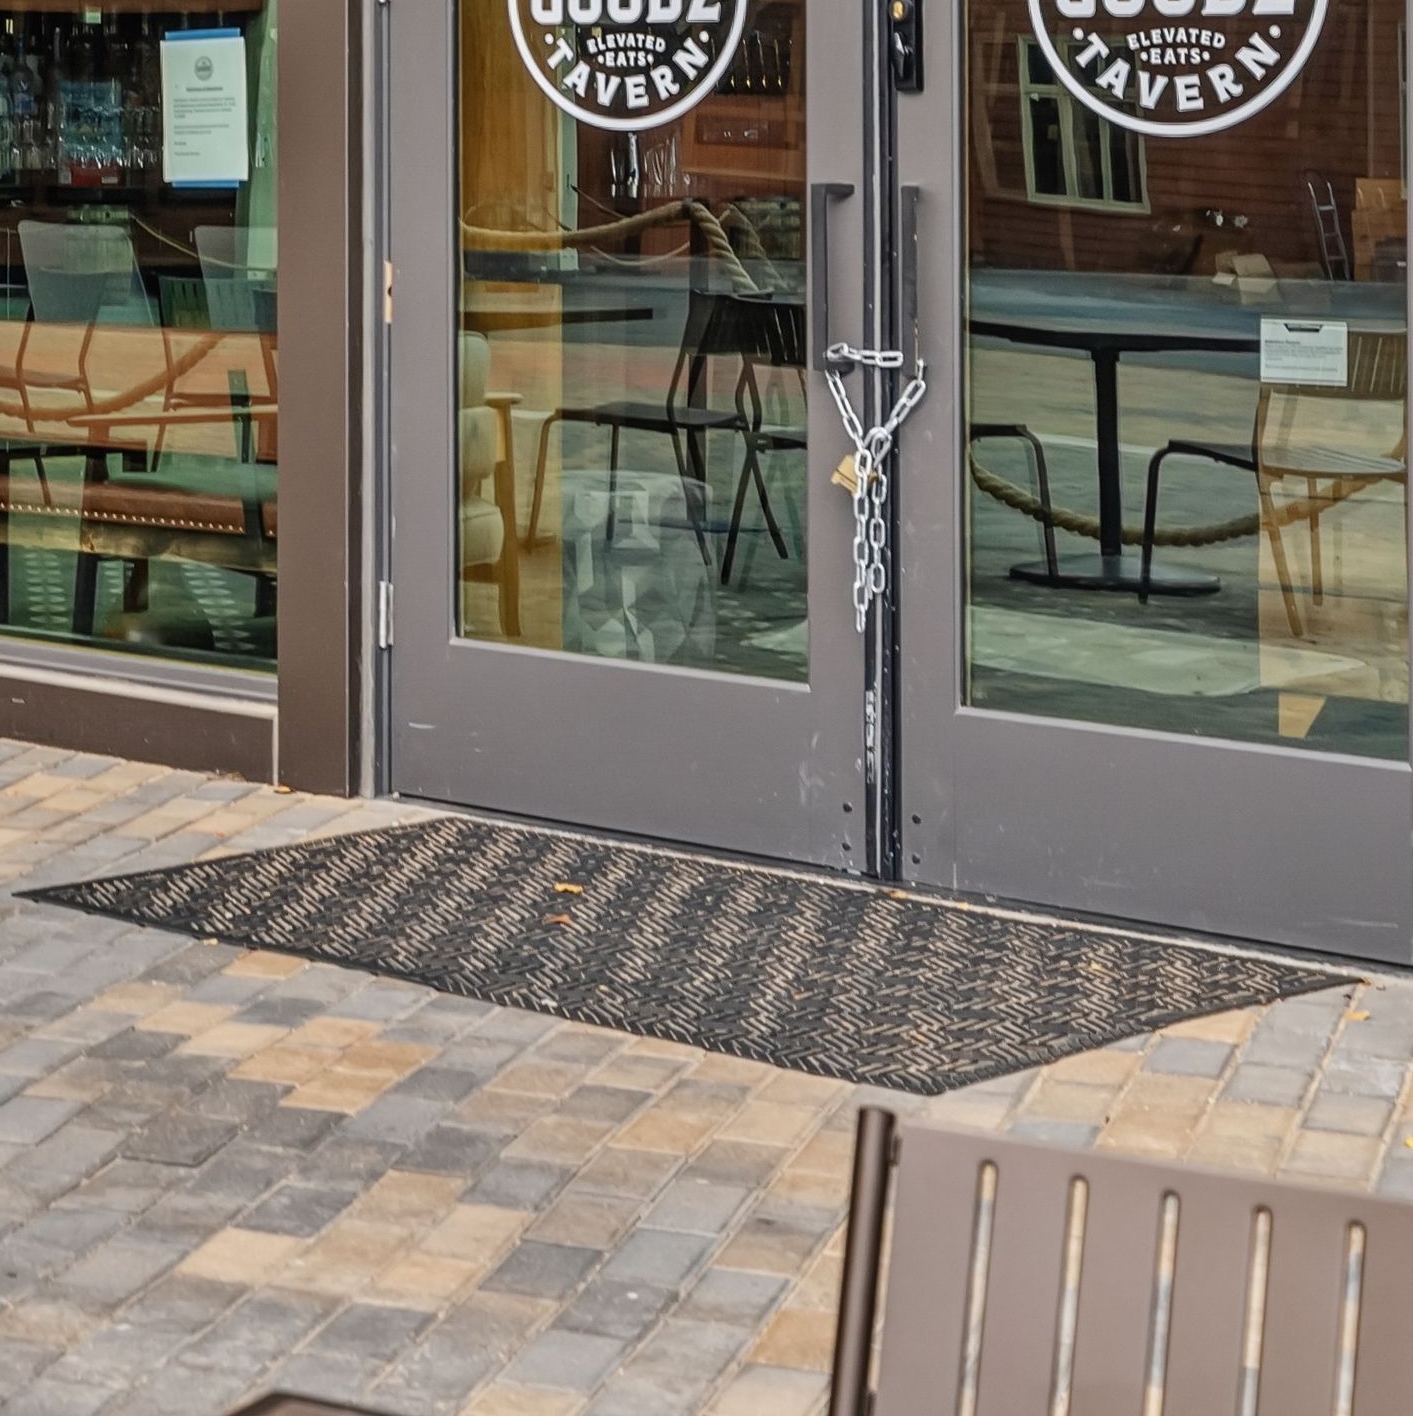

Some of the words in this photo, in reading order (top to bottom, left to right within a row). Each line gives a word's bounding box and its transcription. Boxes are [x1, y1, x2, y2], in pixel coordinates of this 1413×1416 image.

[587, 31, 666, 54] ELEVATED
[1126, 27, 1226, 50] ELEVATED
[605, 50, 648, 68] EATS
[1149, 47, 1203, 66] EATS
[546, 36, 710, 110] TAVERN
[1072, 32, 1281, 113] TAVERN
